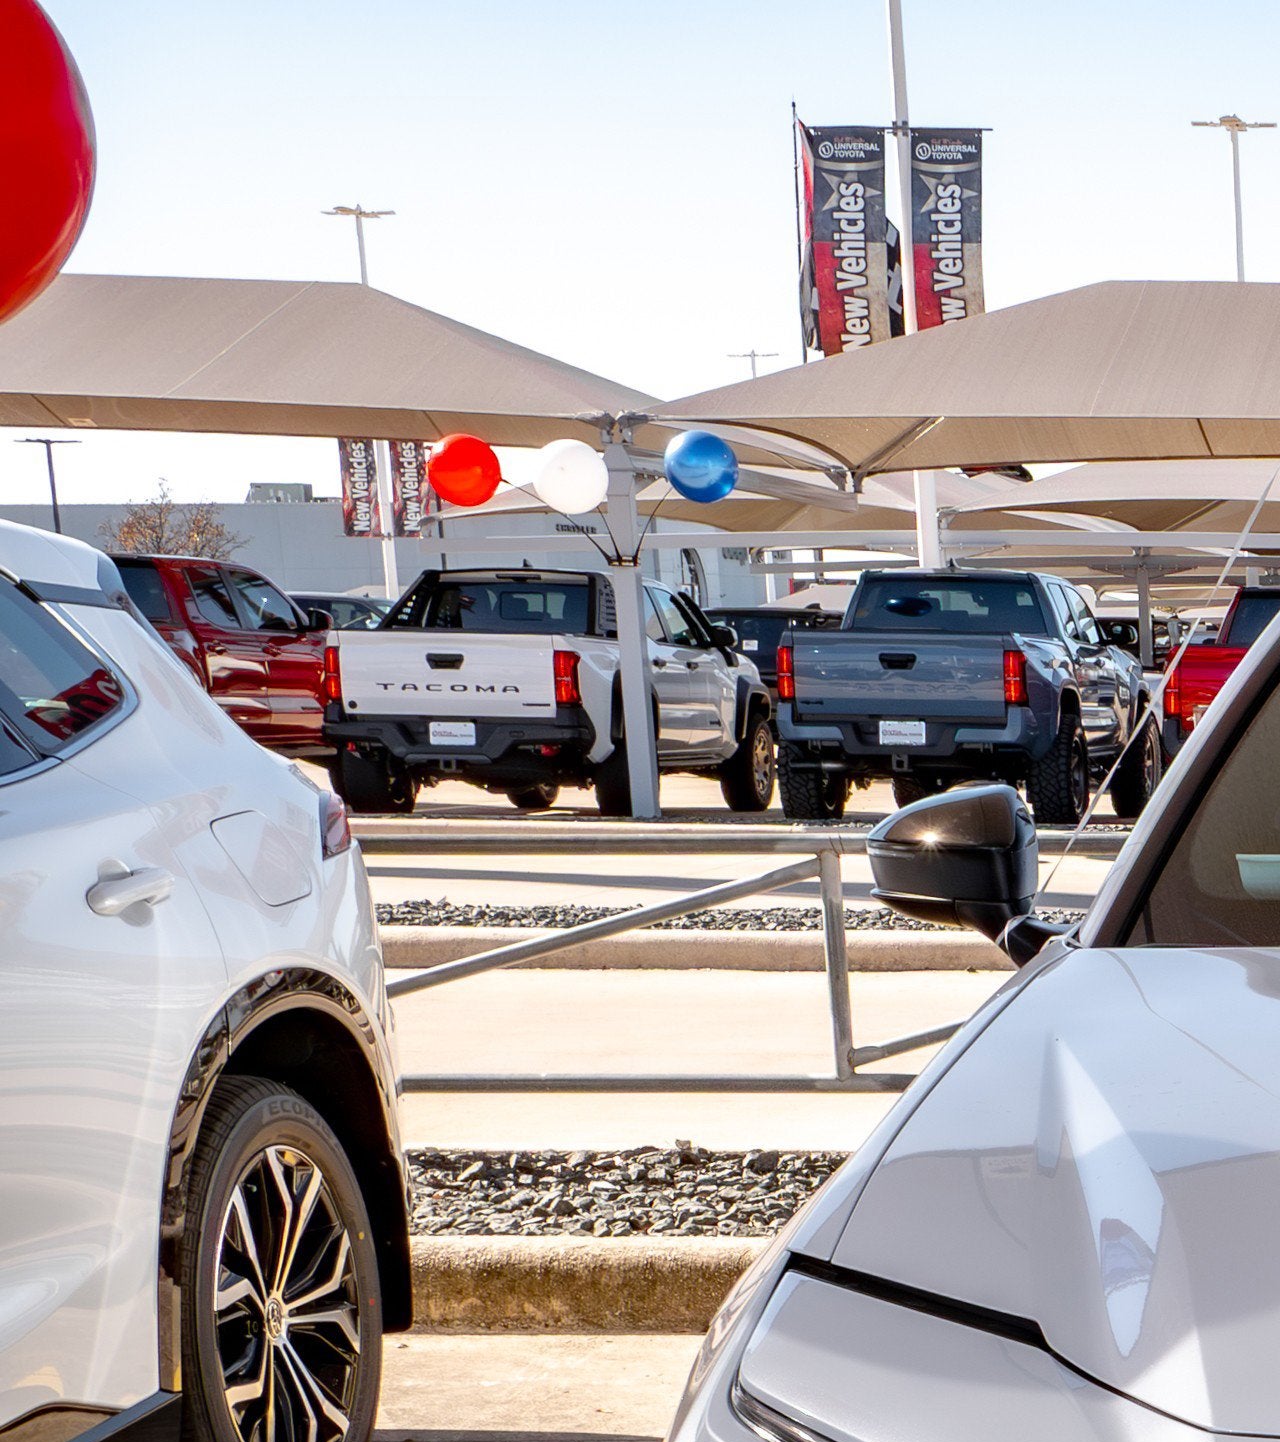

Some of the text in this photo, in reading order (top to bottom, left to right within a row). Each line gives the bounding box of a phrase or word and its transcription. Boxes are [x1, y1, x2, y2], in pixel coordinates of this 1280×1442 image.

[834, 142, 880, 152] UNIVERSAL
[834, 150, 865, 159] TOYOTA
[931, 143, 977, 153] UNIVERSAL
[931, 151, 963, 160] TOYOTA
[832, 181, 868, 291] Vehicles
[930, 183, 967, 291] Vehicles
[841, 295, 871, 352] New
[349, 441, 371, 532] New Vehicles
[399, 441, 421, 532] New Vehicles
[376, 682, 521, 694] TACOMA
